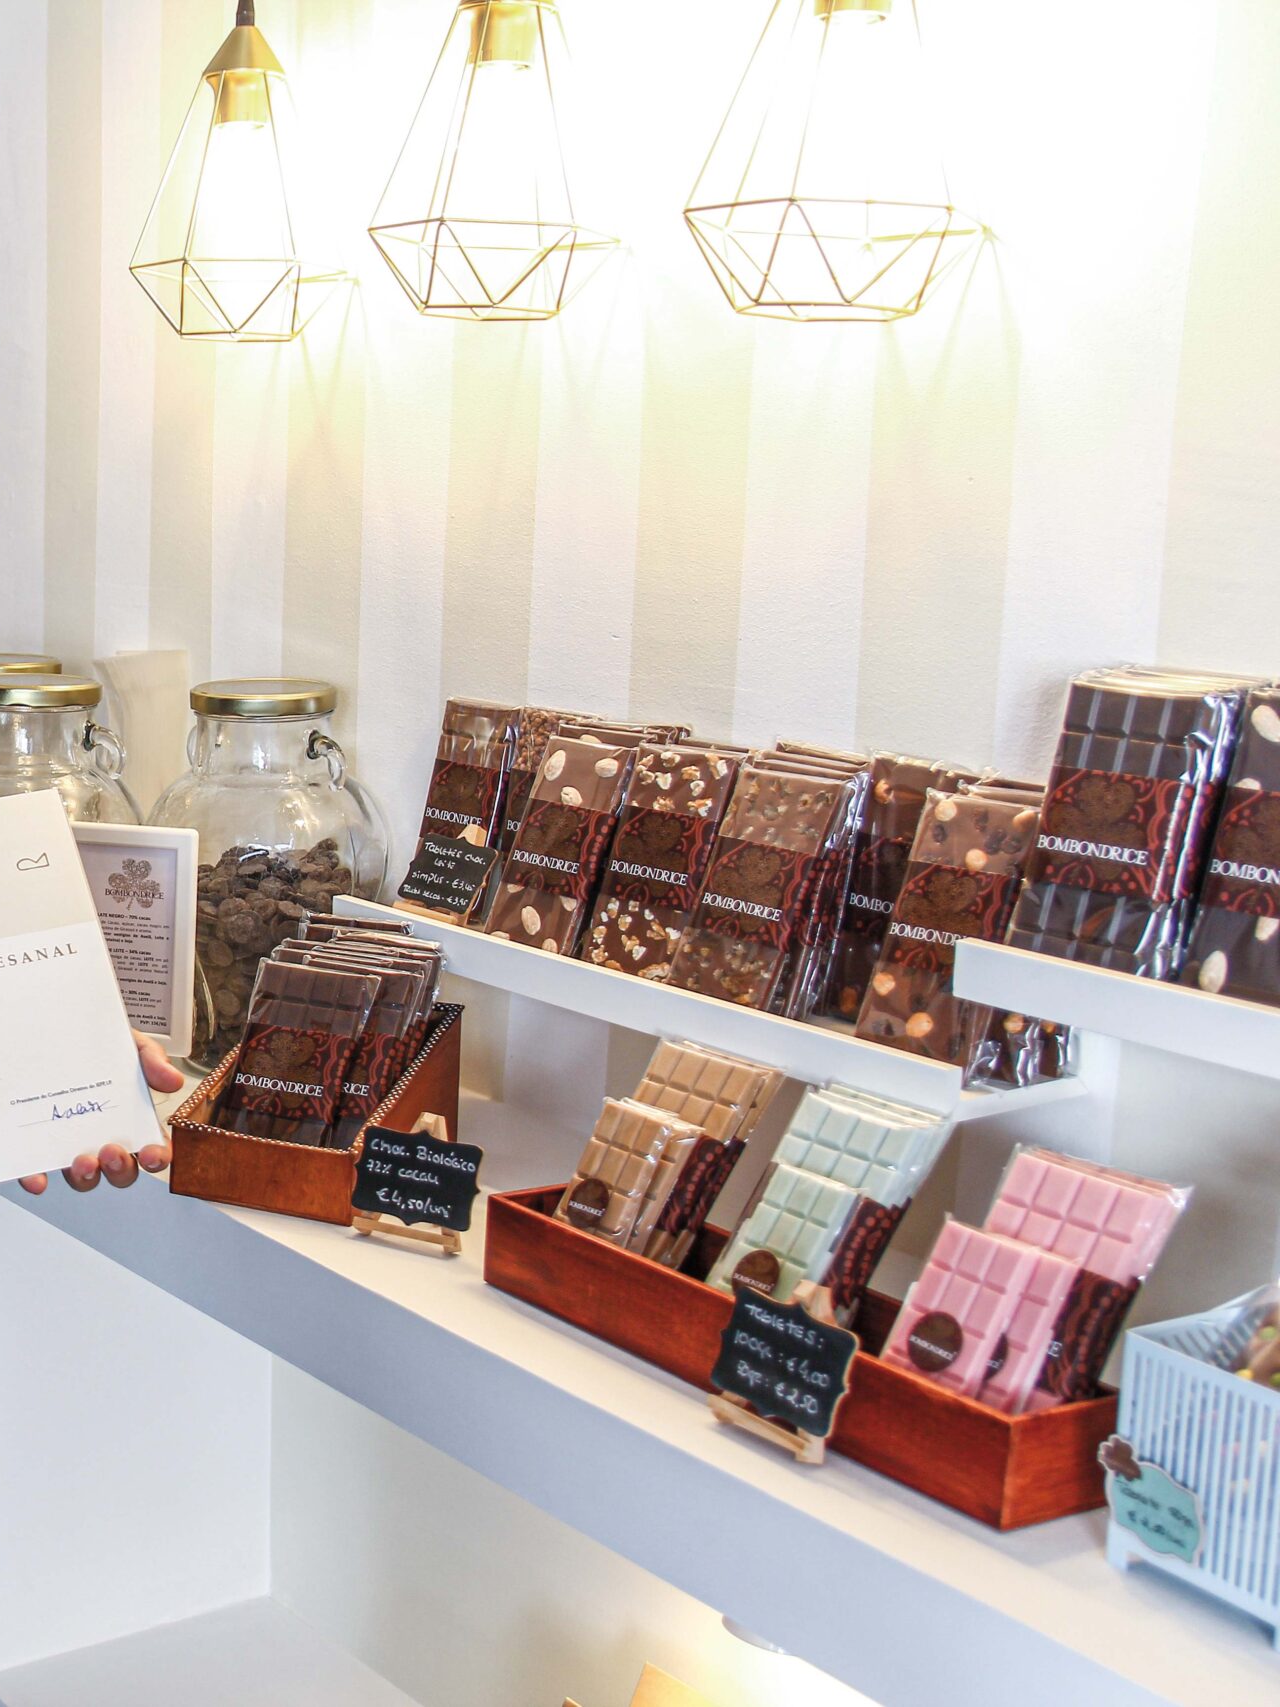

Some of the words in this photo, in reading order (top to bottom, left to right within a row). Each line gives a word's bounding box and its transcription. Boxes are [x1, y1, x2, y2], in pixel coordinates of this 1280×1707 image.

[506, 819, 521, 832] BO
[1036, 834, 1149, 866] BOMBONDRICE
[512, 850, 580, 875] BOMBONDRICE
[610, 860, 688, 886] BOMBONDRICE
[105, 888, 164, 900] BOMBONDRICE
[849, 893, 894, 914] BOMBO
[702, 892, 782, 922] BOMBONDRICE
[889, 922, 966, 946] BOMBONDR
[235, 1073, 324, 1097] BOMBONDRICE
[371, 1139, 410, 1155] Choc.
[398, 1168, 439, 1184] cacau
